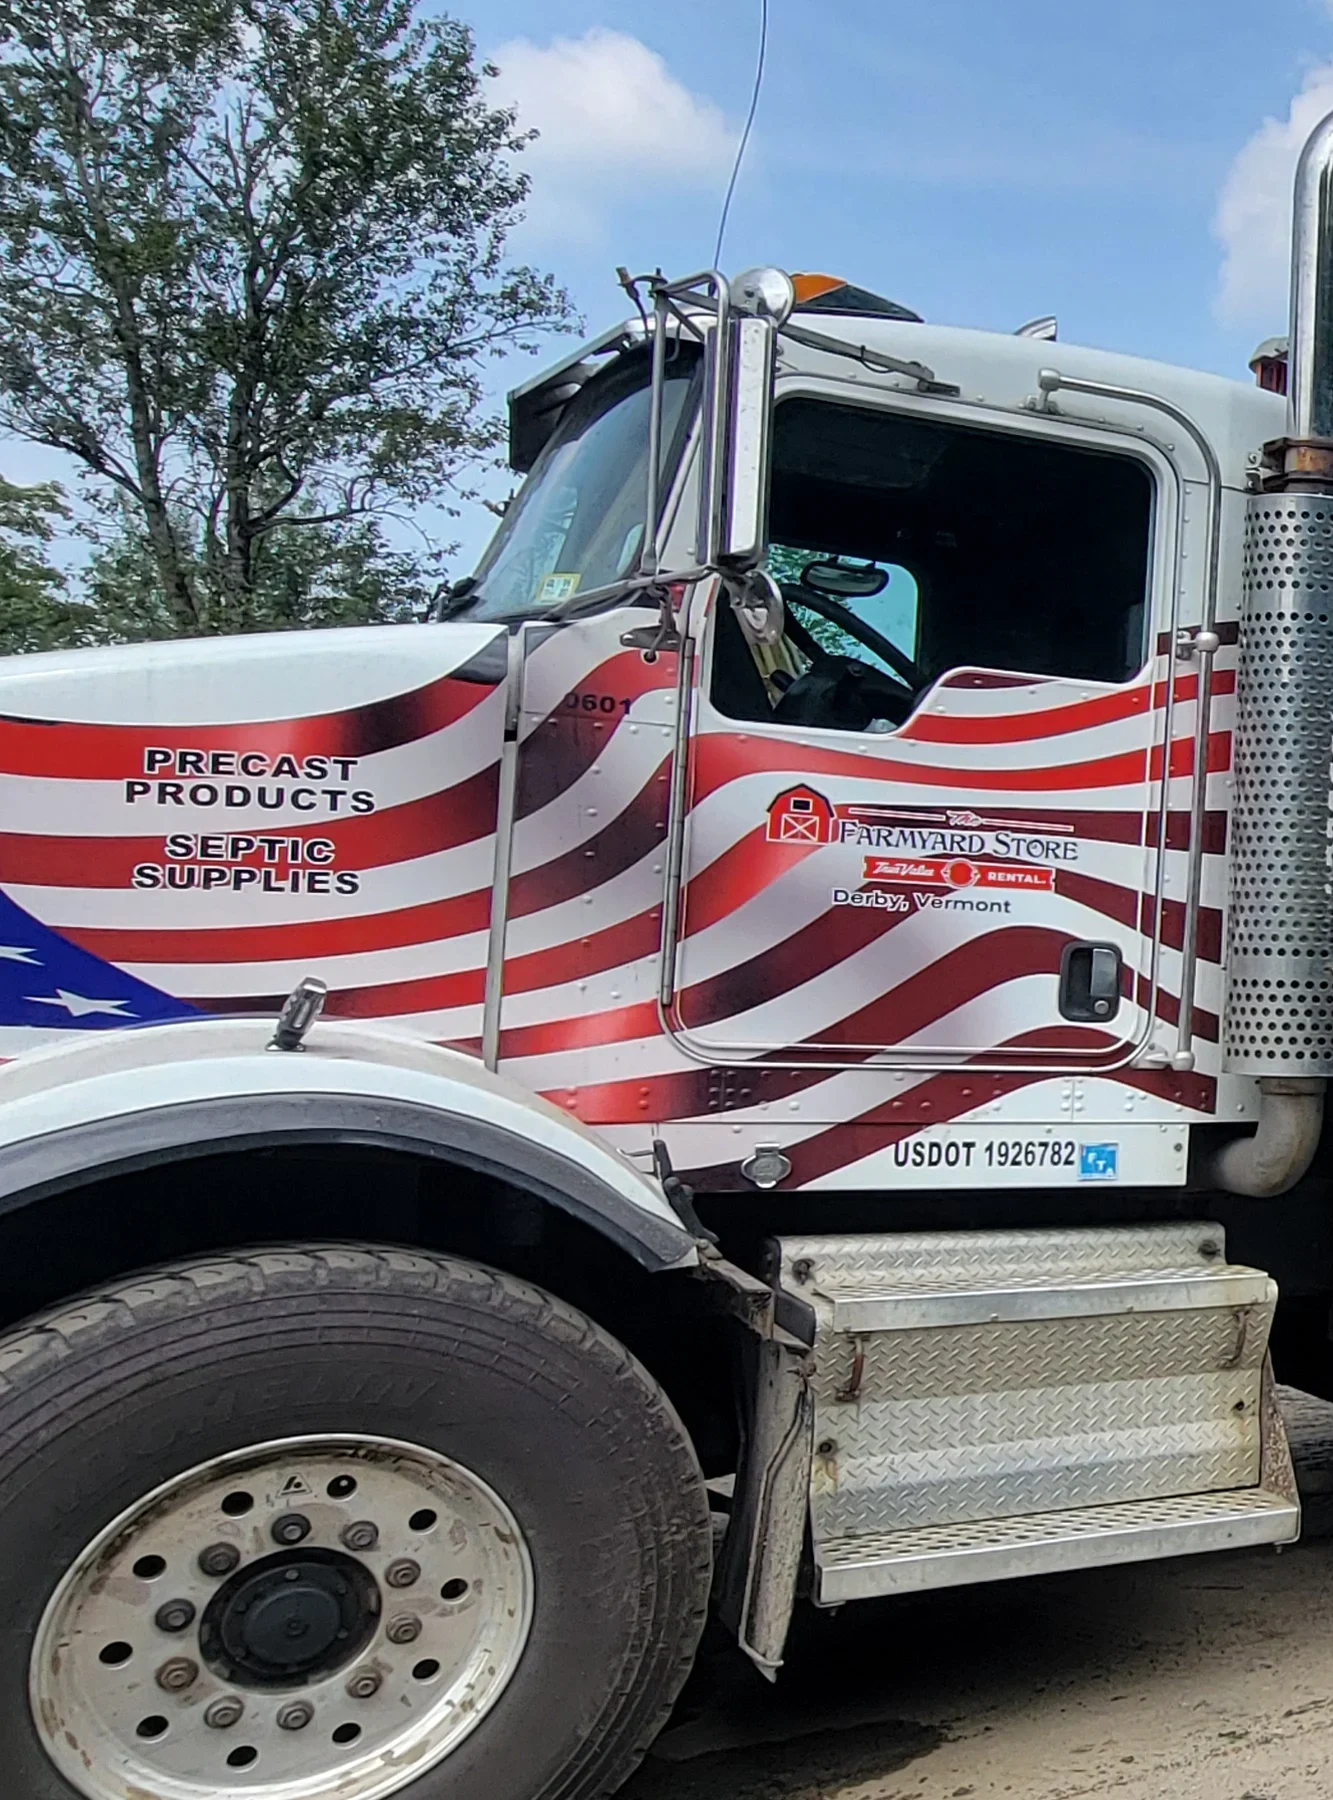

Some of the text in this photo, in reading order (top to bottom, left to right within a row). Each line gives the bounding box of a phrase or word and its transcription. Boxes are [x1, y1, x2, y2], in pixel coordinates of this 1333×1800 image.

[565, 692, 630, 715] 0601
[145, 748, 359, 782] PRECAST
[125, 780, 376, 813] PRODUCTS
[166, 834, 335, 863] SEPTIC
[840, 820, 1079, 860] FARMYARD STORE
[134, 865, 360, 895] SUPPLIES
[833, 889, 1011, 914] Derby, Vermont
[893, 1140, 1076, 1168] USDOT 1926782
